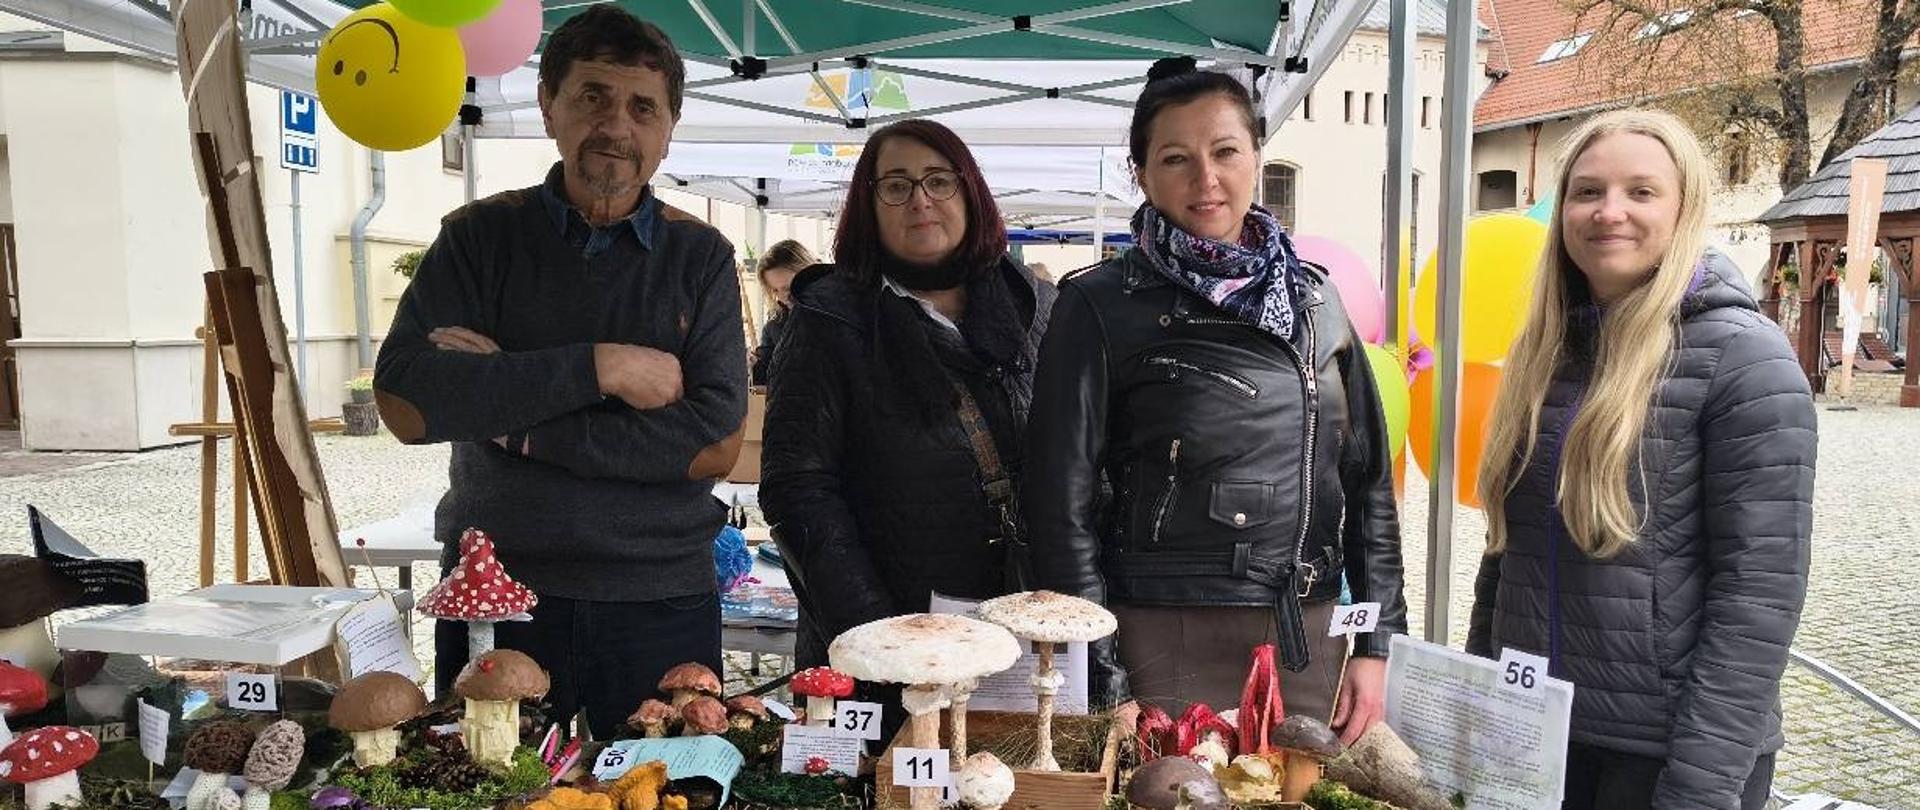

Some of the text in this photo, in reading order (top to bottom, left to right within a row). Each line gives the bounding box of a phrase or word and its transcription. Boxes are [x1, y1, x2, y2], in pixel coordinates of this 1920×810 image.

[291, 93, 309, 124] P
[1342, 609, 1368, 627] 48
[1504, 661, 1536, 689] 56
[237, 681, 266, 703] 29
[844, 709, 874, 731] 37
[906, 756, 934, 780] 11
